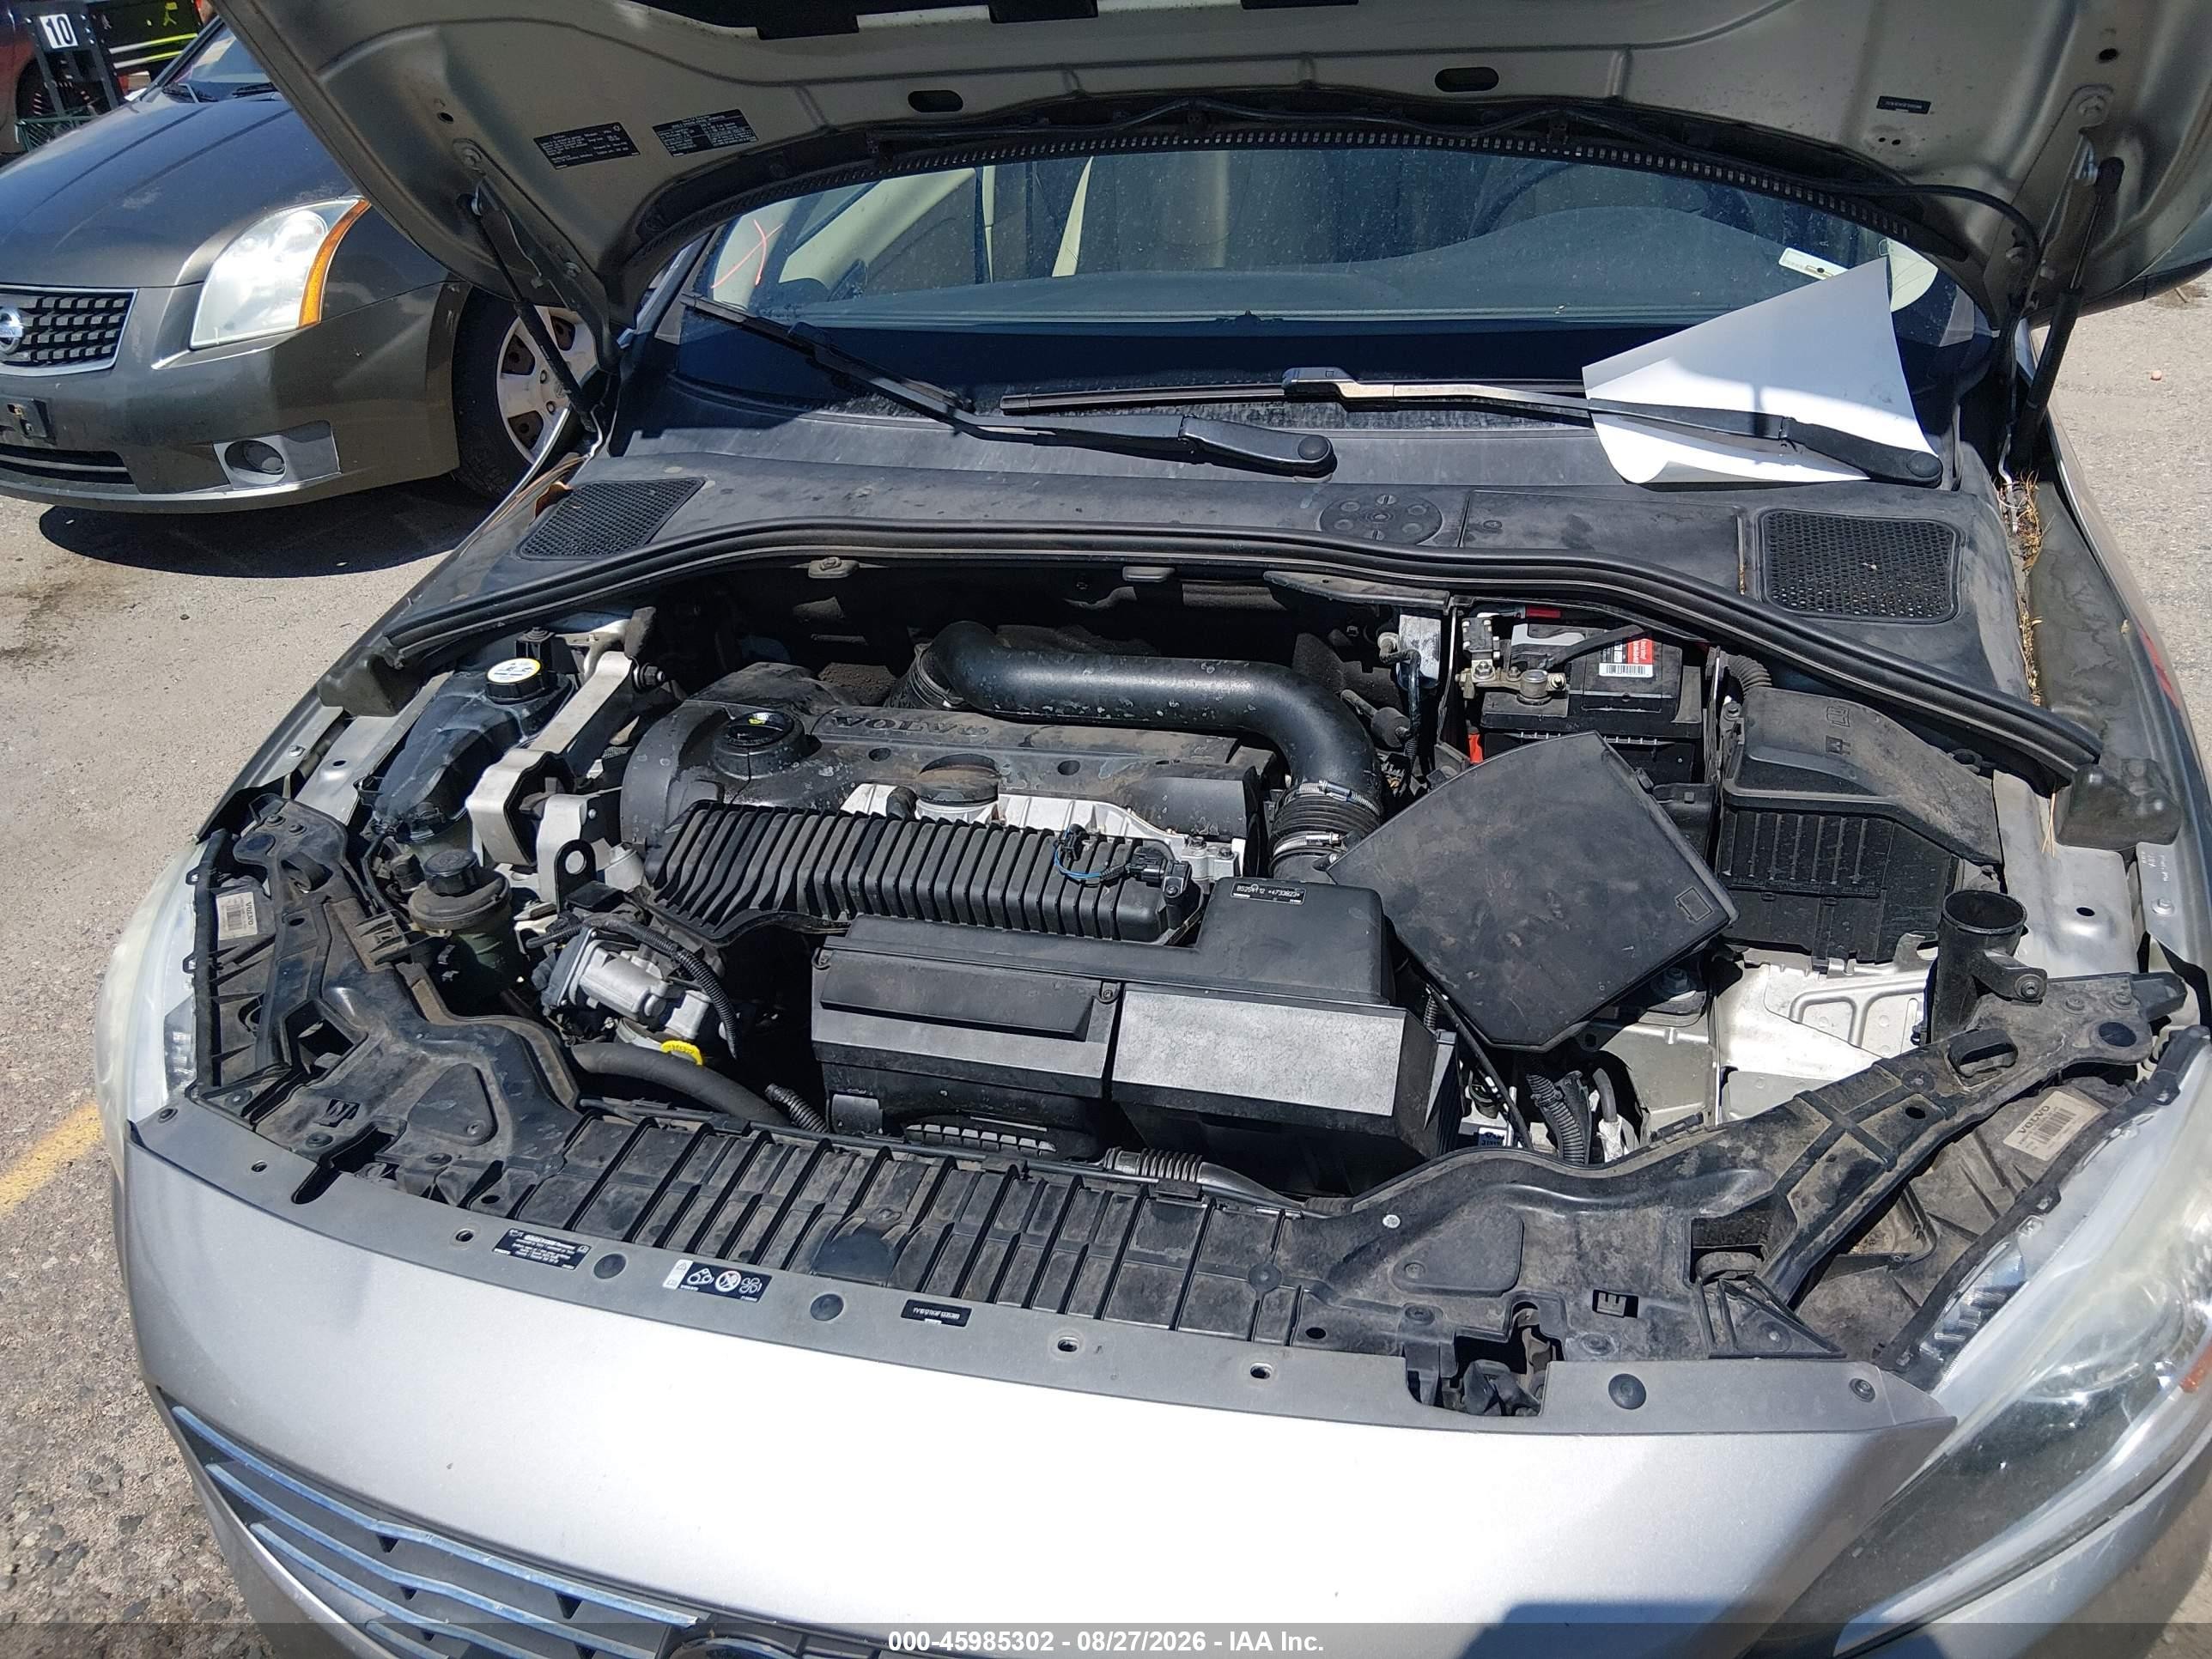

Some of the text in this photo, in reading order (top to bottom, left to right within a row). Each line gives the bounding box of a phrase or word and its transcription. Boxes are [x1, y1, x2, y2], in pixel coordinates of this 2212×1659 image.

[46, 15, 74, 45] 10
[832, 715, 988, 736] VOLVO
[246, 902, 254, 926] VOLVO
[2017, 1104, 2051, 1134] VOLVO
